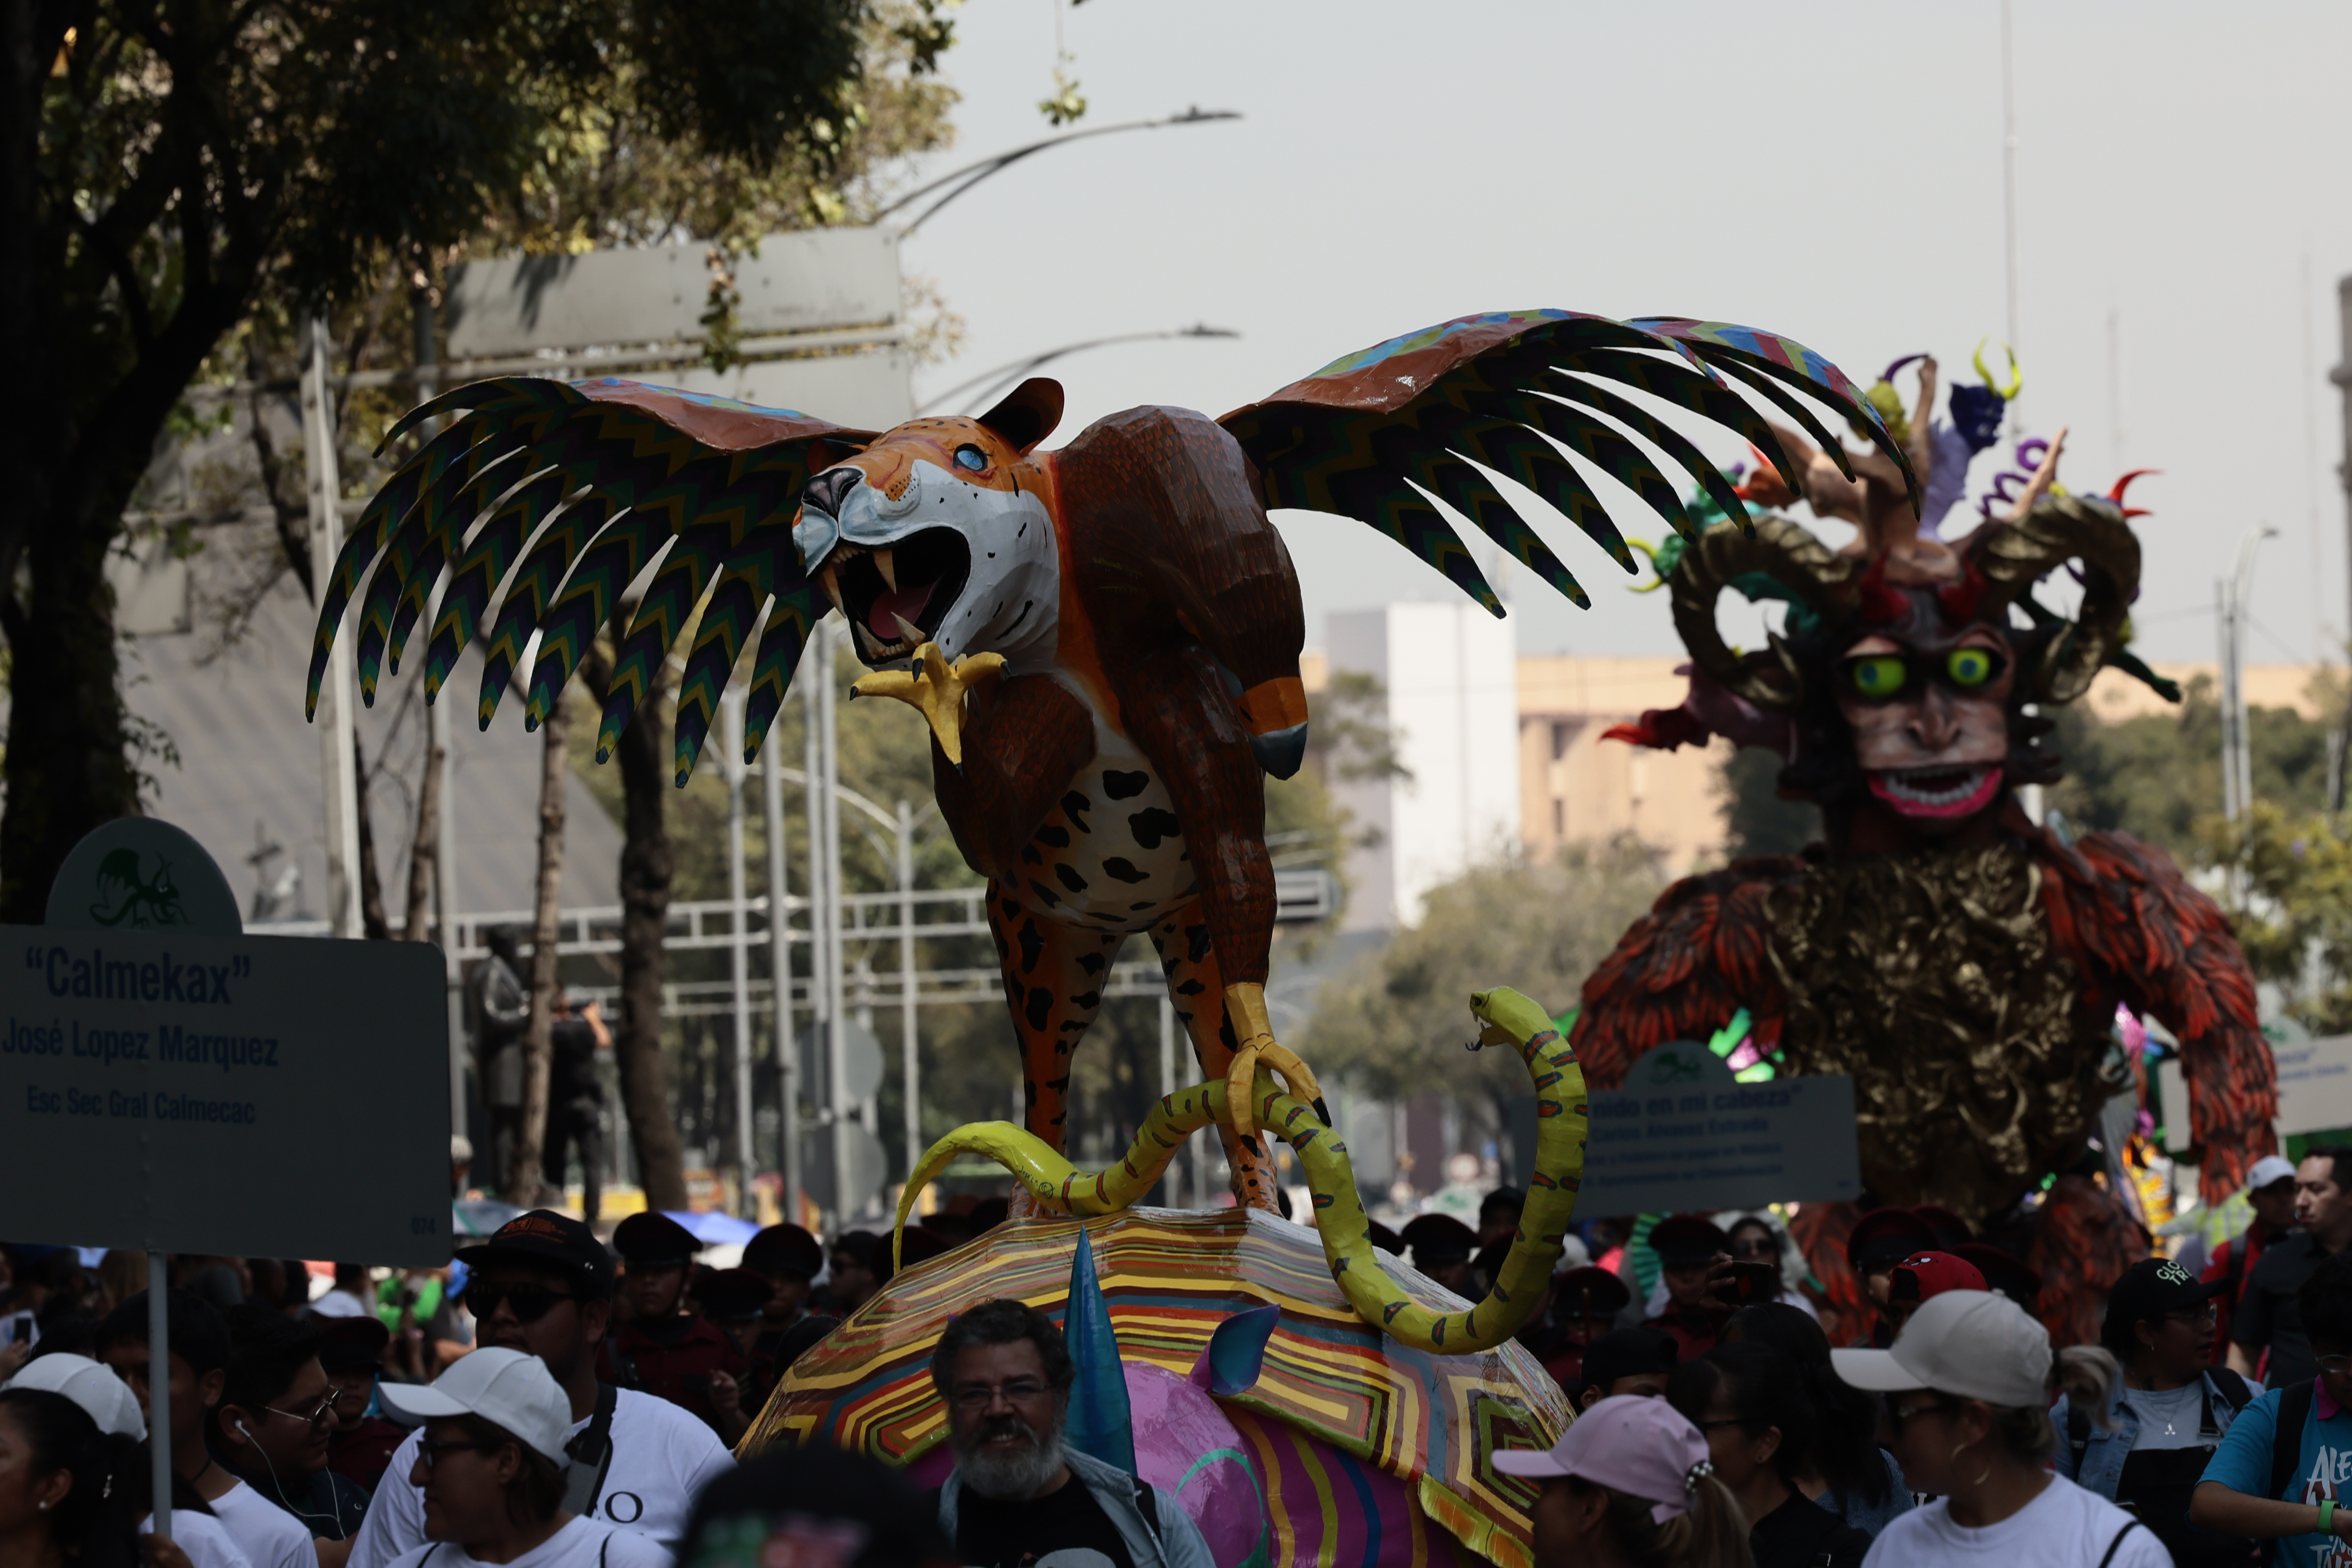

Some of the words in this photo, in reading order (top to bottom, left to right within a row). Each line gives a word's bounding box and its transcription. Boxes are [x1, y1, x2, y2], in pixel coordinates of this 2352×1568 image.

[26, 946, 250, 1004] “Calmekax”
[1, 1017, 64, 1055] José
[73, 1021, 150, 1066] Lopez
[159, 1024, 279, 1072] Marquez
[27, 1085, 61, 1113] Esc
[67, 1088, 103, 1116] Sec
[109, 1089, 148, 1118] Gral
[154, 1092, 255, 1123] Calmecac
[1647, 1098, 1673, 1115] en
[1680, 1093, 1708, 1112] mi
[411, 1217, 436, 1234] 074
[2306, 1444, 2352, 1505] ALE
